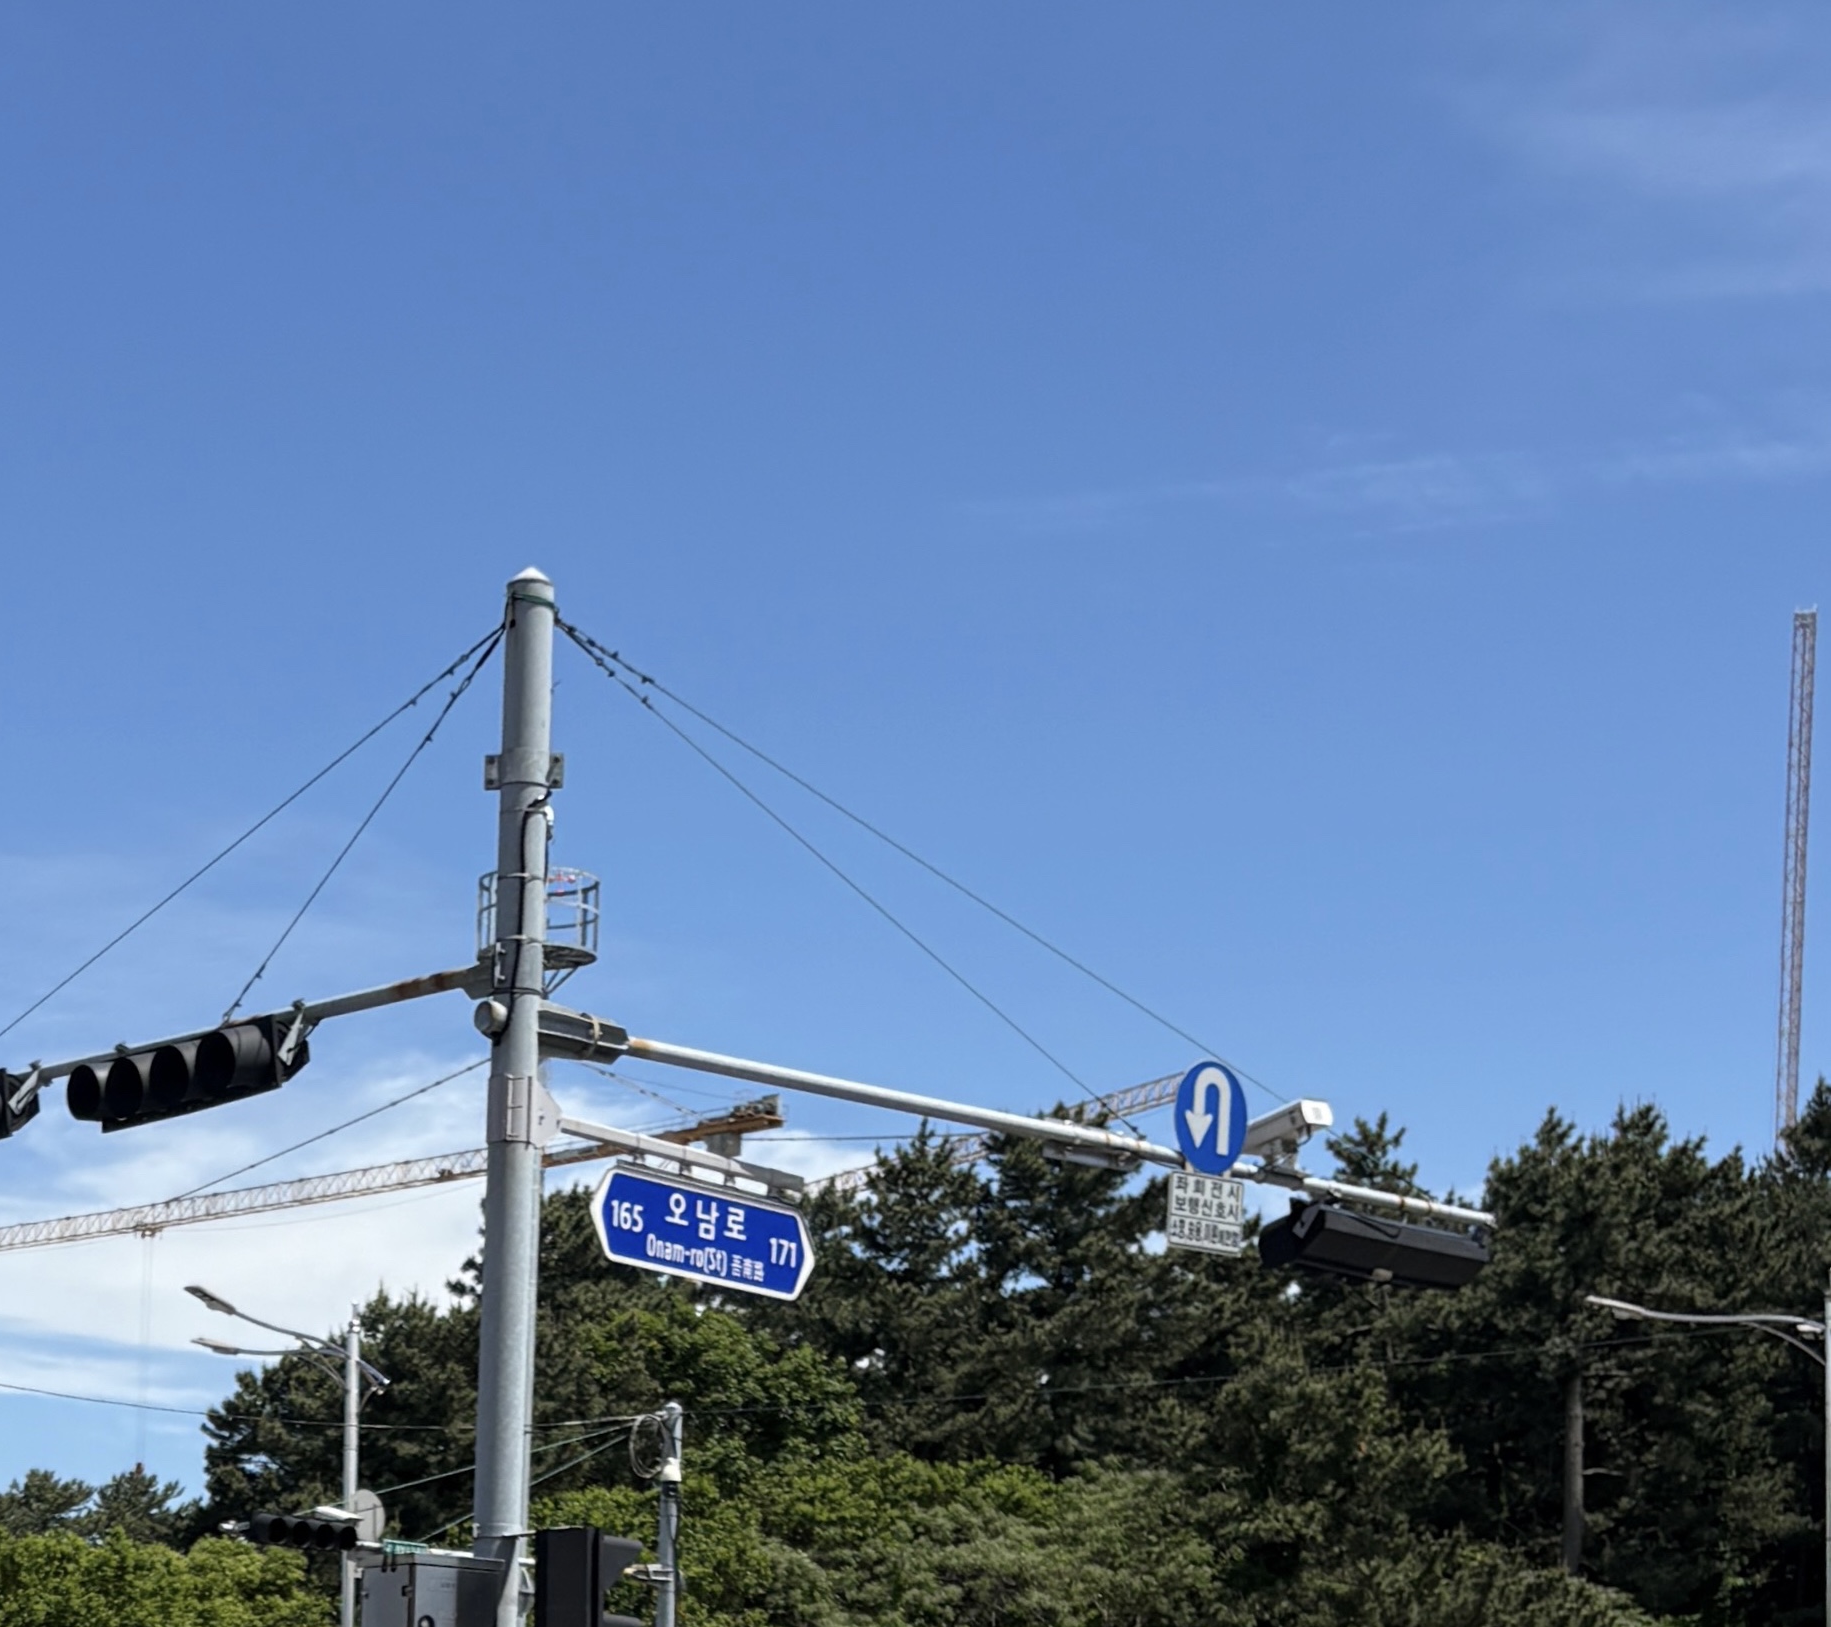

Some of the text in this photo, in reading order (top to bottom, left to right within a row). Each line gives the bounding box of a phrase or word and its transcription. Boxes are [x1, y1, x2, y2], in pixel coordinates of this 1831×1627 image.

[611, 1193, 797, 1268] 165 오남로 171
[646, 1233, 728, 1277] Onam-ro(St)
